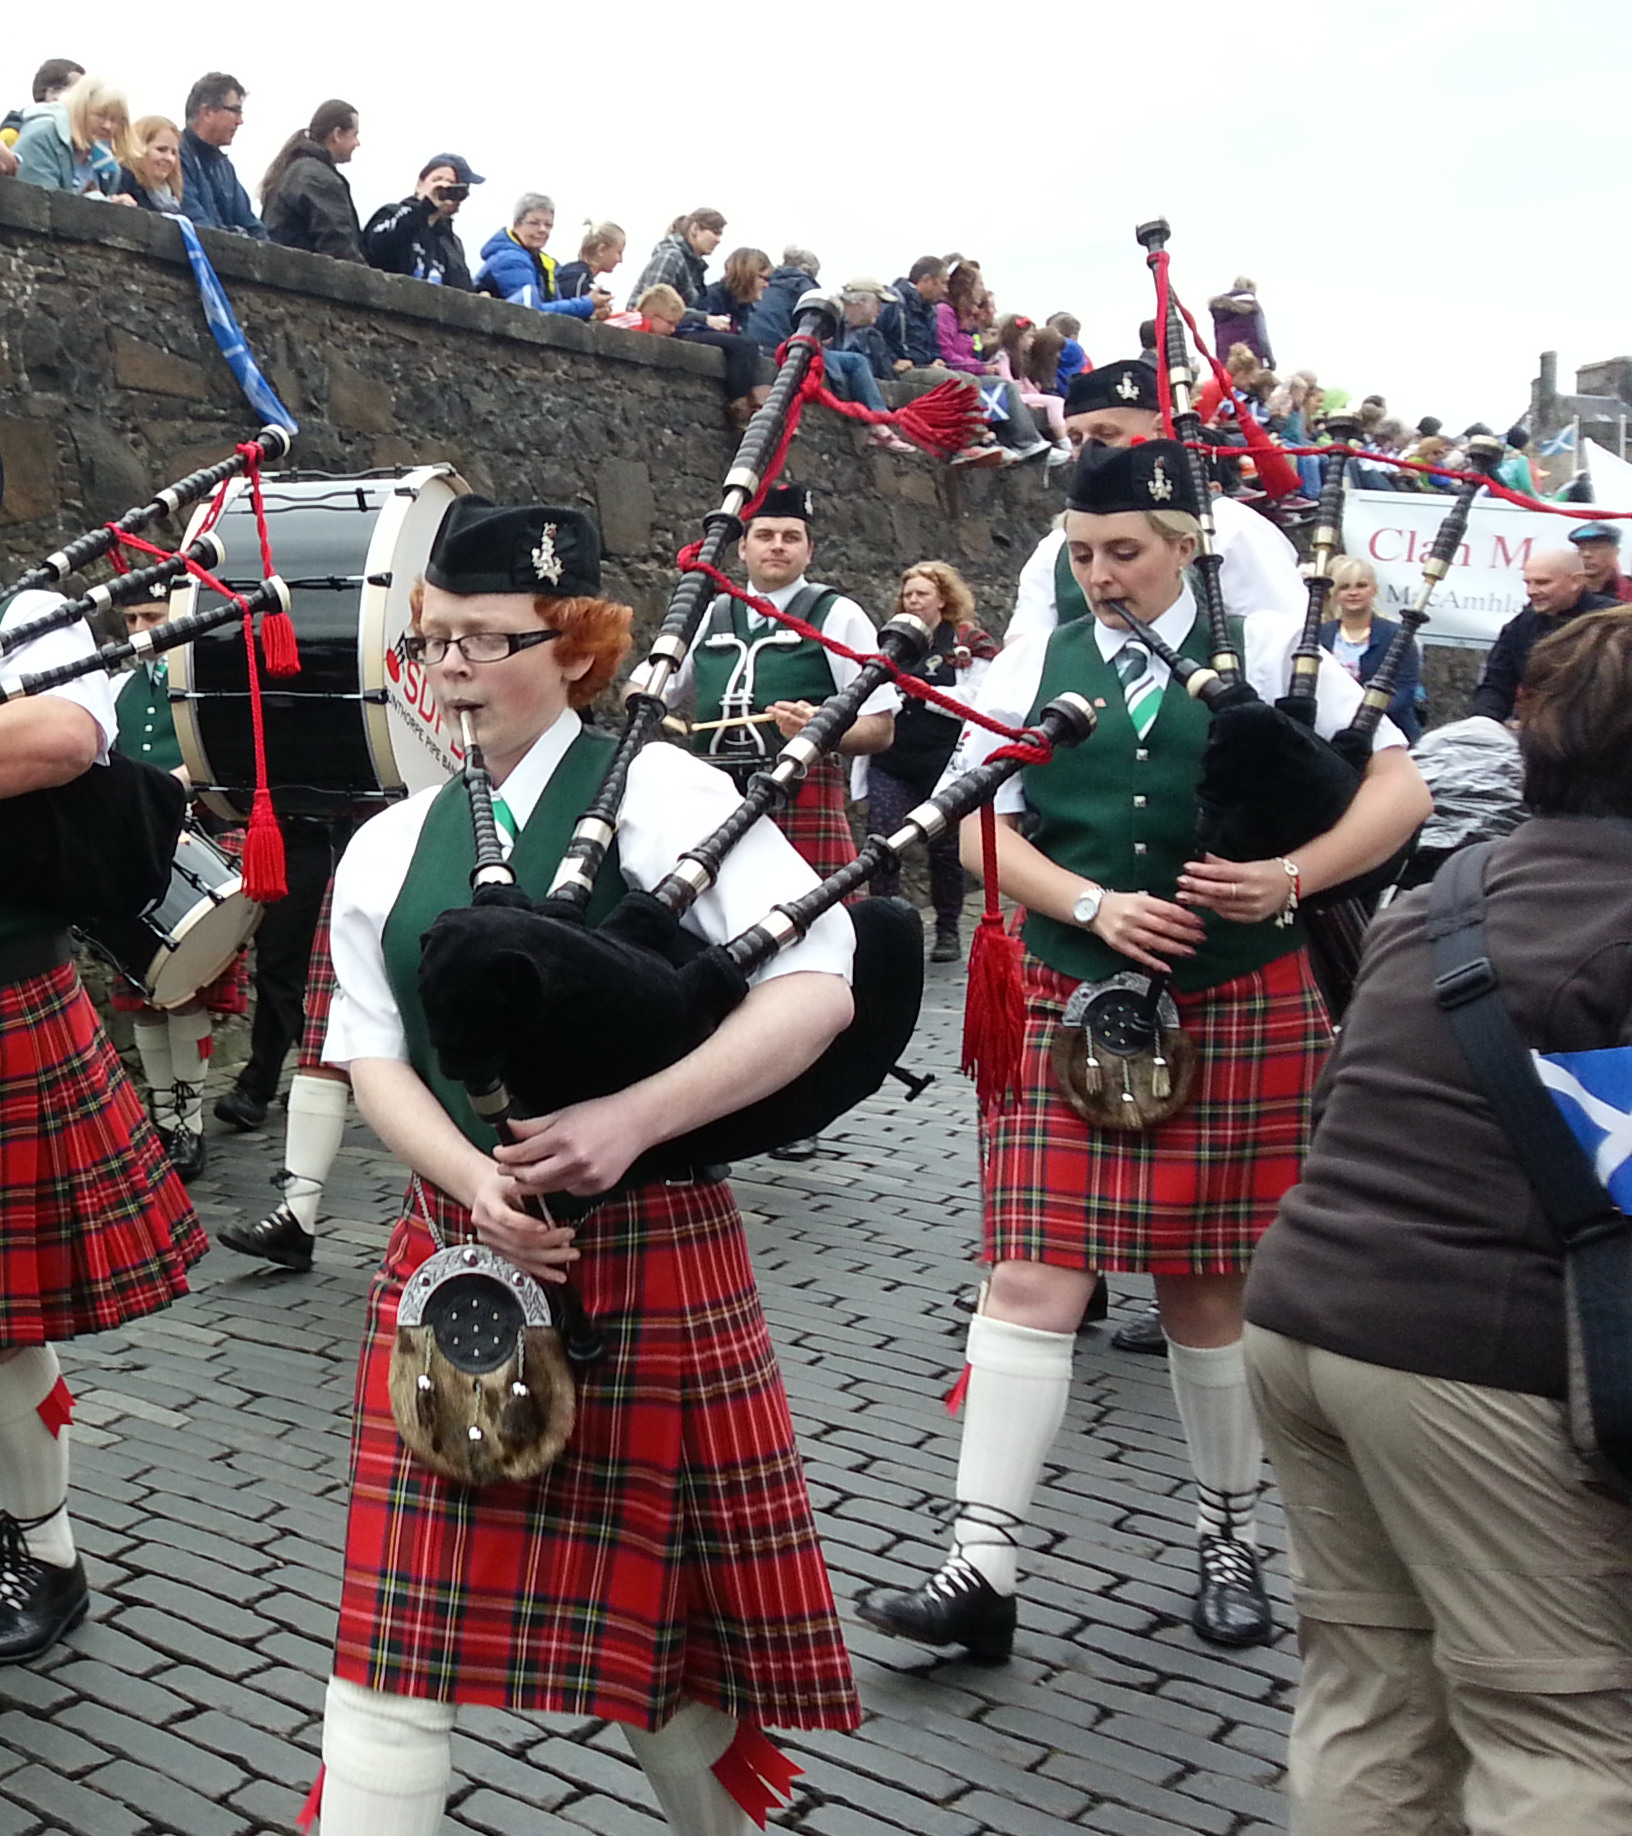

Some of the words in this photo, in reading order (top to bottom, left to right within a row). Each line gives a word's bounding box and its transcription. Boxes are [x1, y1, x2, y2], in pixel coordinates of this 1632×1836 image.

[1490, 534, 1536, 571] M
[1386, 584, 1527, 614] MacAmhla
[424, 735, 442, 763] PIPE
[441, 753, 459, 776] BAN
